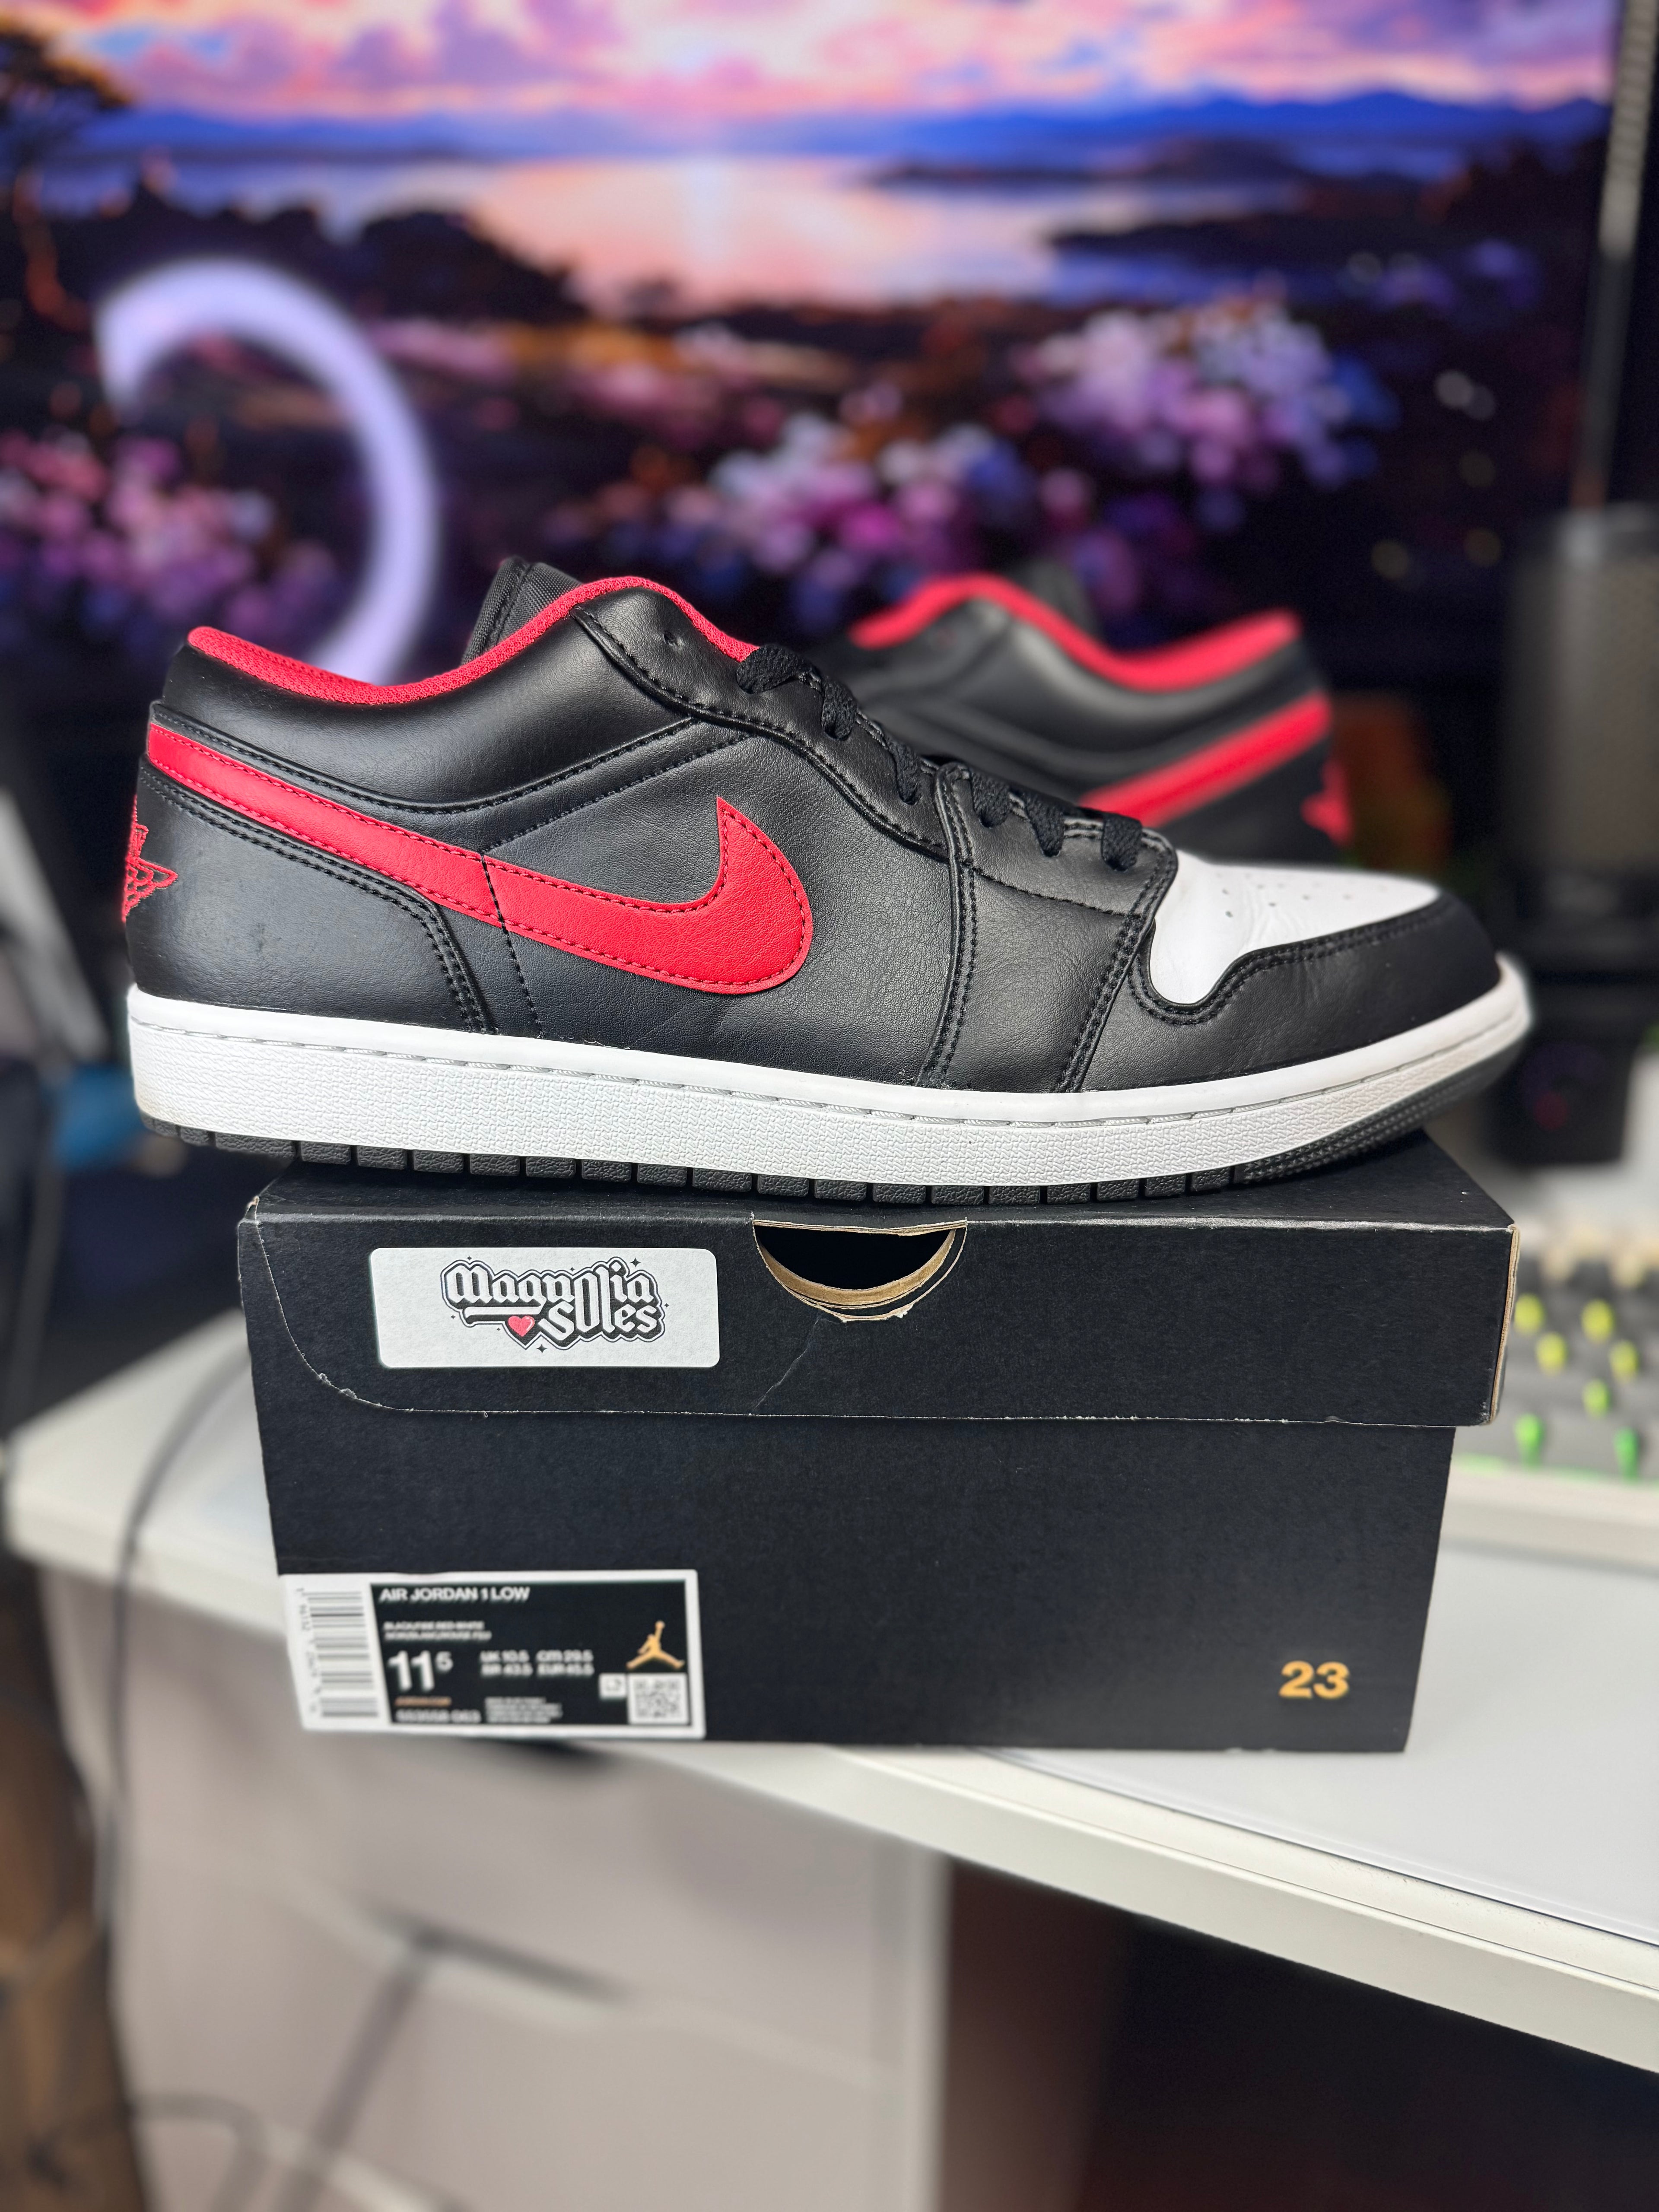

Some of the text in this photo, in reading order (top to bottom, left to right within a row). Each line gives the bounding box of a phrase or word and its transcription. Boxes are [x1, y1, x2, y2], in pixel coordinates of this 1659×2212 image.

[379, 1586, 530, 1602] AIR JORDAN 1 LOW
[388, 1650, 434, 1691] 11
[1278, 1660, 1350, 1699] 23
